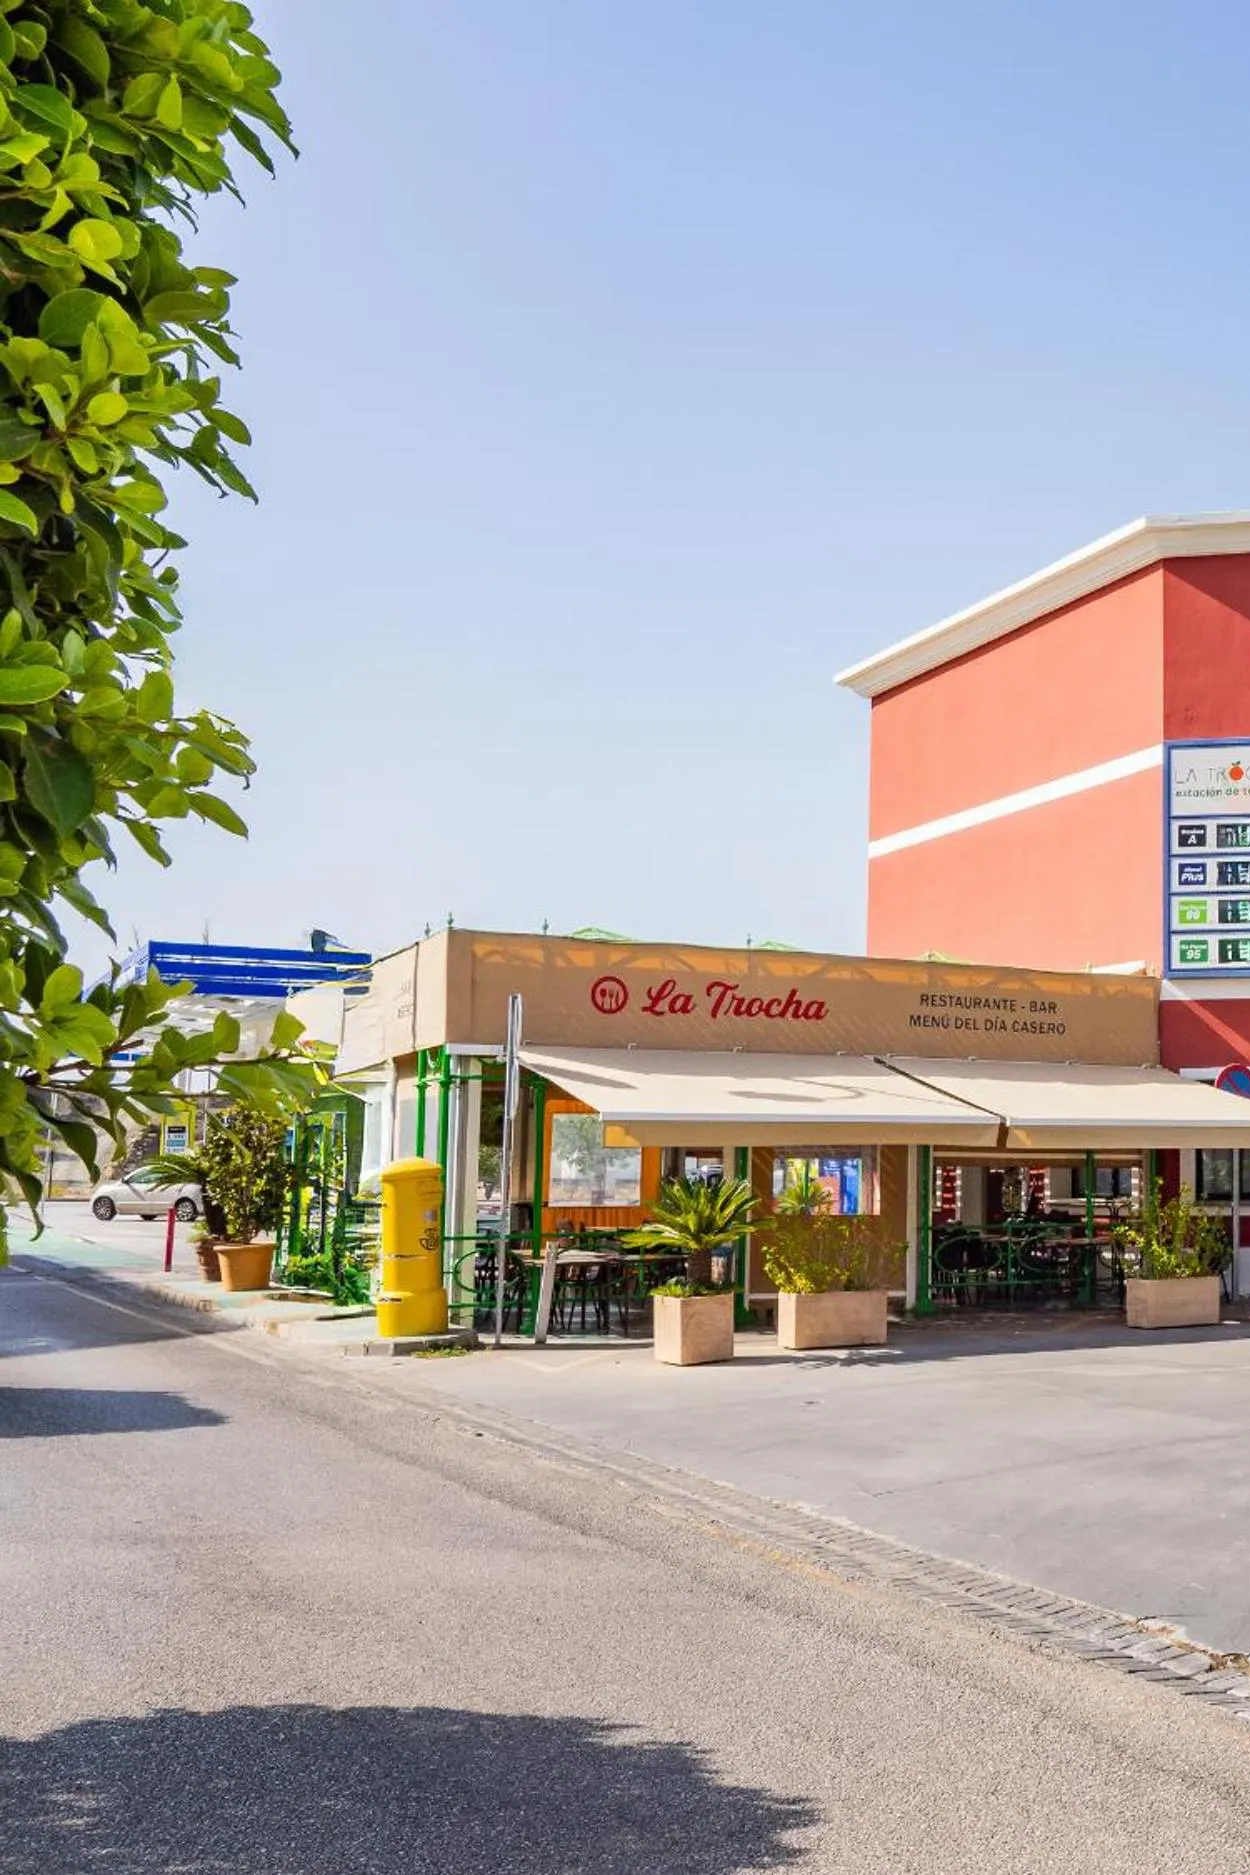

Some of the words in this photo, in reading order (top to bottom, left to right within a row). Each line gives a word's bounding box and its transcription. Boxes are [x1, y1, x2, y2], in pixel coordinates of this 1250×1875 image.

[1175, 768, 1198, 784] LA
[1225, 787, 1239, 796] de
[1181, 872, 1204, 882] Plus
[1186, 948, 1201, 960] 95
[642, 979, 697, 1017] La
[706, 981, 829, 1020] Trocha
[920, 993, 1017, 1012] RESTAURANTE
[1029, 1001, 1058, 1014] BAR
[909, 1013, 950, 1029] MENÚ
[954, 1018, 980, 1031] DEL
[984, 1016, 1008, 1033] DÍA
[1011, 1020, 1066, 1036] CASERO
